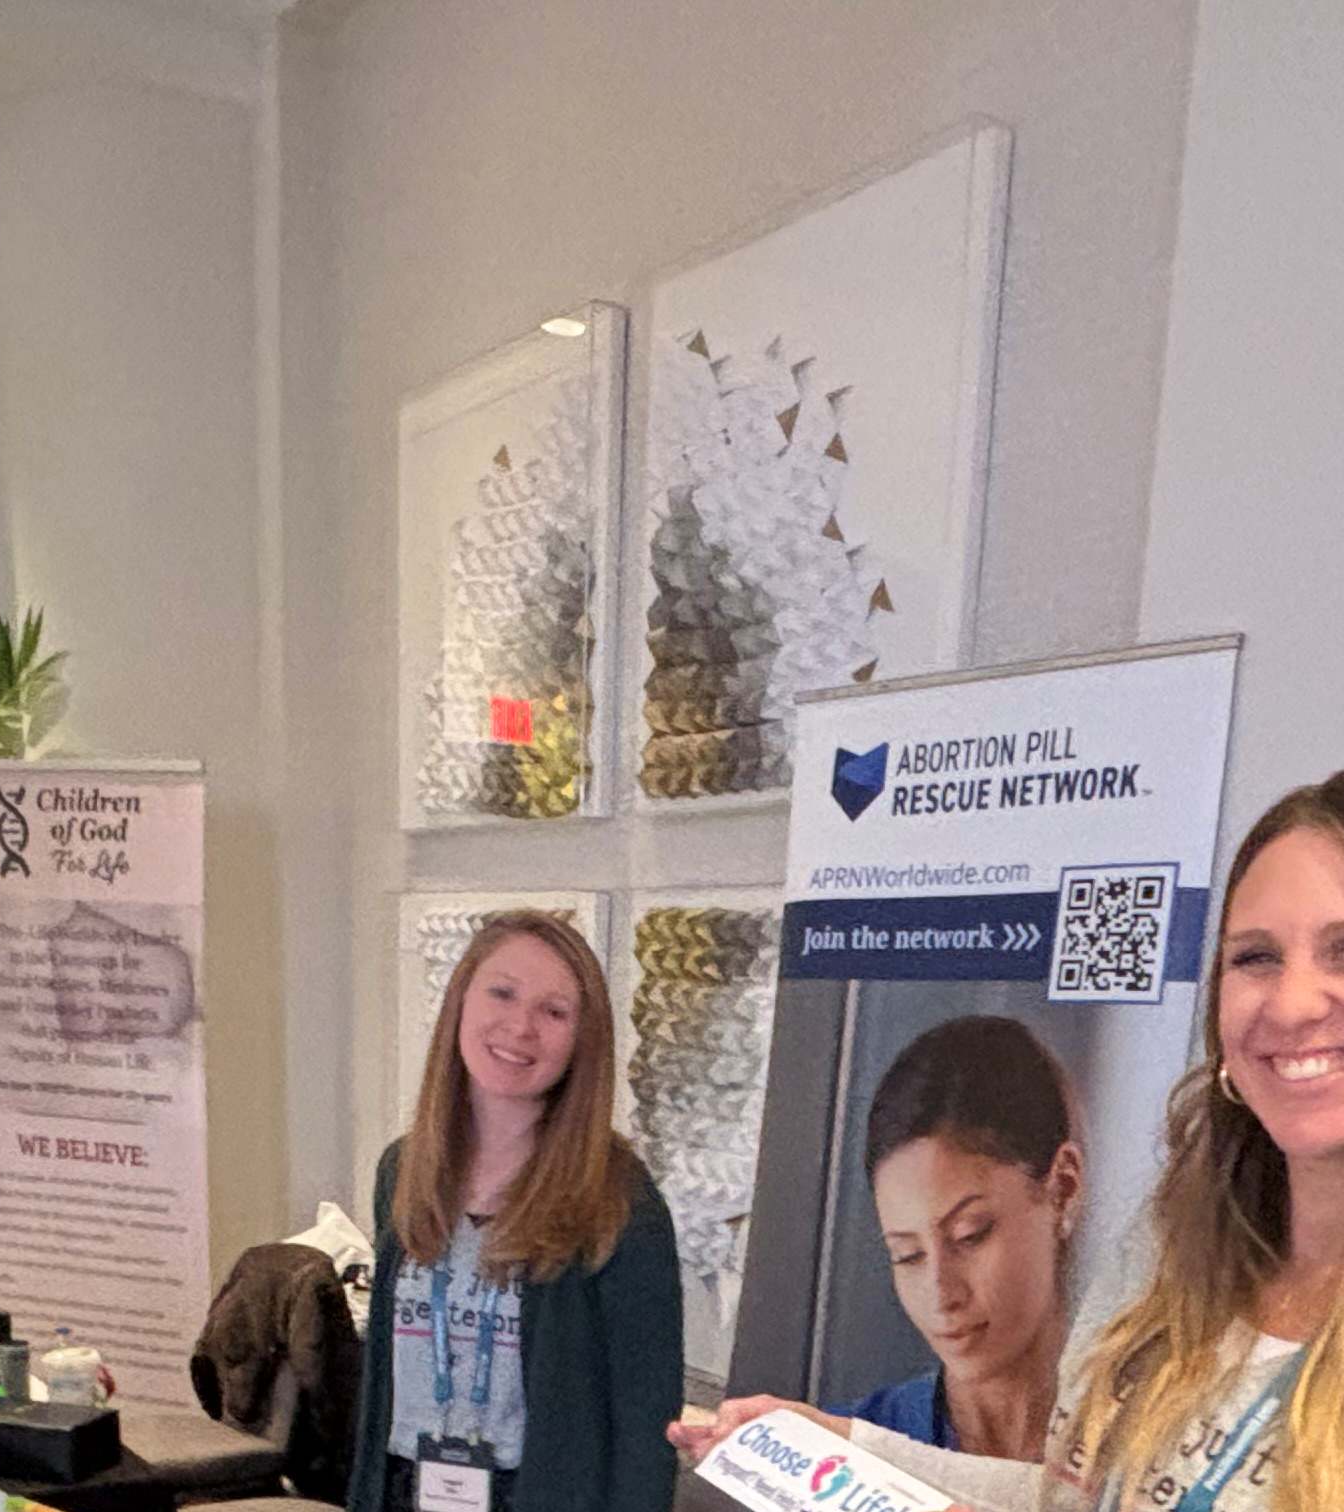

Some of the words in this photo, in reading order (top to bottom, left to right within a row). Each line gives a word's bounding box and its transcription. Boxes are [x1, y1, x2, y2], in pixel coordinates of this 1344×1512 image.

[896, 733, 1017, 776] ABORTION
[1025, 726, 1077, 763] PILL
[36, 788, 141, 813] Children
[891, 778, 992, 816] RESCUE
[999, 764, 1140, 808] NETWORK
[51, 819, 78, 845] of
[79, 818, 128, 843] God
[809, 863, 1030, 889] APRNWorldwide.com
[801, 926, 845, 956] Join
[851, 925, 890, 950] the
[895, 923, 995, 949] network
[17, 1133, 51, 1159] WE
[737, 1423, 812, 1477] Choose
